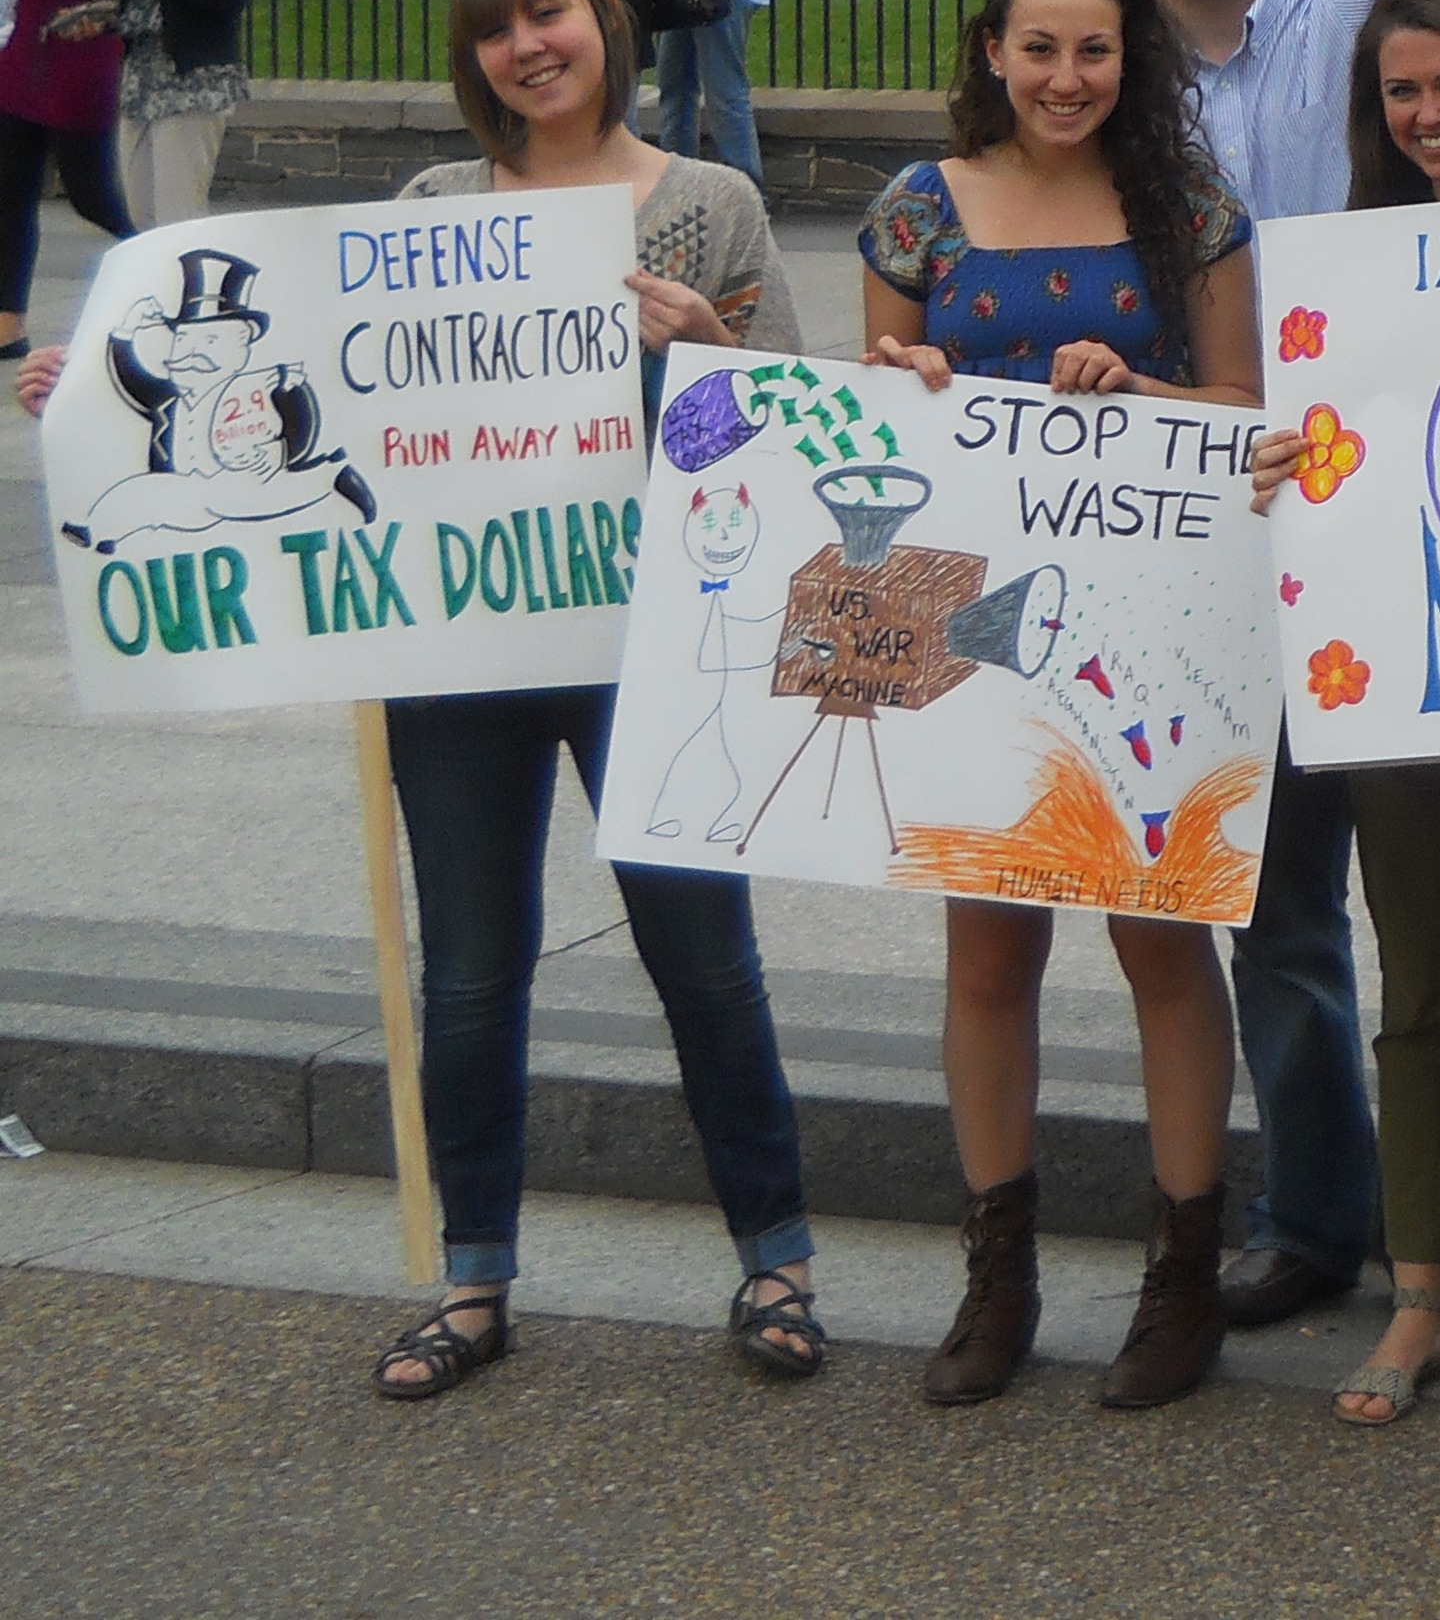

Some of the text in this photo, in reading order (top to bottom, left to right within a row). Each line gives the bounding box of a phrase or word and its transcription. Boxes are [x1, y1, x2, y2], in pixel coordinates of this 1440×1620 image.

[339, 214, 534, 295] DEFENSE
[341, 302, 629, 396] CONTRACTORS
[222, 389, 264, 423] 2.9
[954, 394, 1129, 460] STOP
[383, 416, 634, 468] RUN AWAY WITH
[1017, 475, 1222, 542] WASTE
[98, 495, 643, 658] OUR TAX DOLLARS
[853, 624, 917, 667] WAR
[1100, 641, 1150, 707] IRAQ
[799, 671, 907, 706] MACHINE
[996, 866, 1187, 914] HUMAN NEEDS
